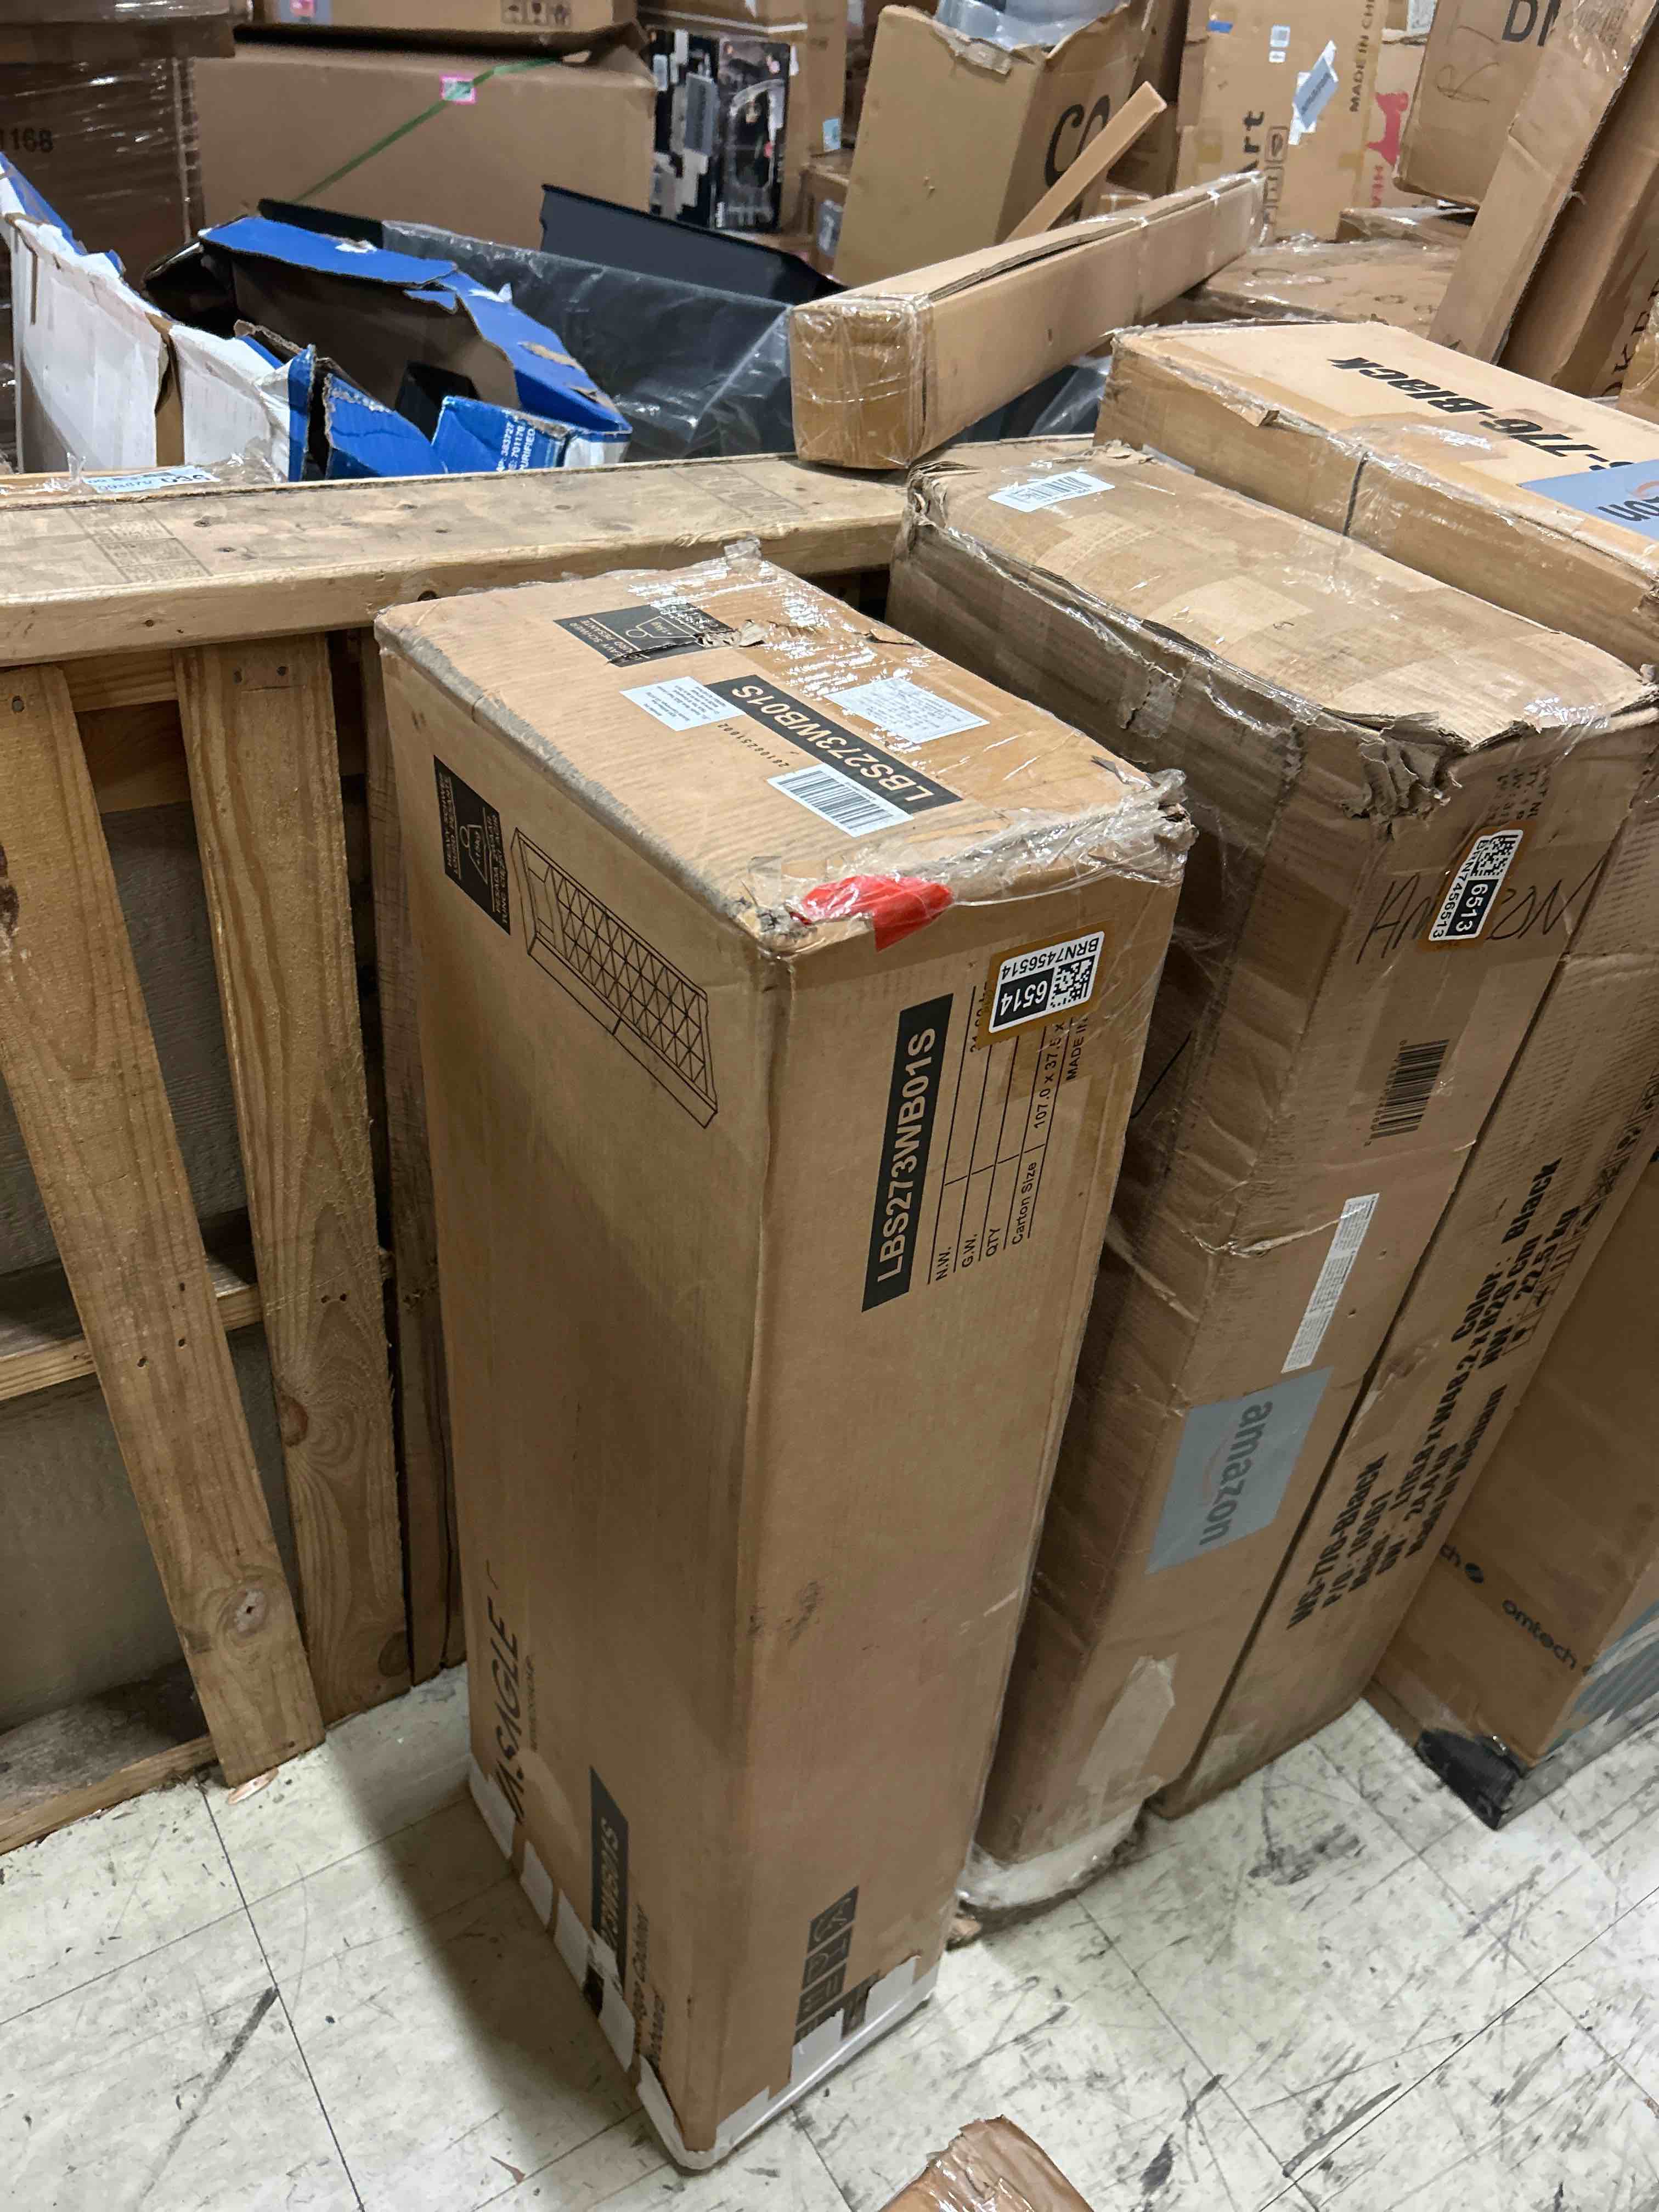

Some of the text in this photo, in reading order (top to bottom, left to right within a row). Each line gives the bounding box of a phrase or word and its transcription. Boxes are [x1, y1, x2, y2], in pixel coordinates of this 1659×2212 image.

[1349, 60, 1364, 112] MADE
[731, 685, 935, 802] LBS273WB01S
[1432, 839, 1489, 939] BRN7456513
[1455, 883, 1488, 932] 6513
[1001, 937, 1099, 980] BRN7456514
[1001, 980, 1048, 1016] 6514
[1065, 1040, 1083, 1081] MADE
[878, 1027, 936, 1283] LBS273WB01S
[1012, 1196, 1030, 1245] Carton
[1021, 1161, 1037, 1194] Size
[1034, 1088, 1051, 1128] 107.0
[1044, 1073, 1054, 1085] x
[1500, 1158, 1562, 1244] Black
[935, 1246, 952, 1282] N.W.
[962, 1233, 978, 1268] G.W.
[985, 1227, 1001, 1257] QTY
[1506, 1233, 1543, 1278] cm
[1199, 1401, 1273, 1545] amazon
